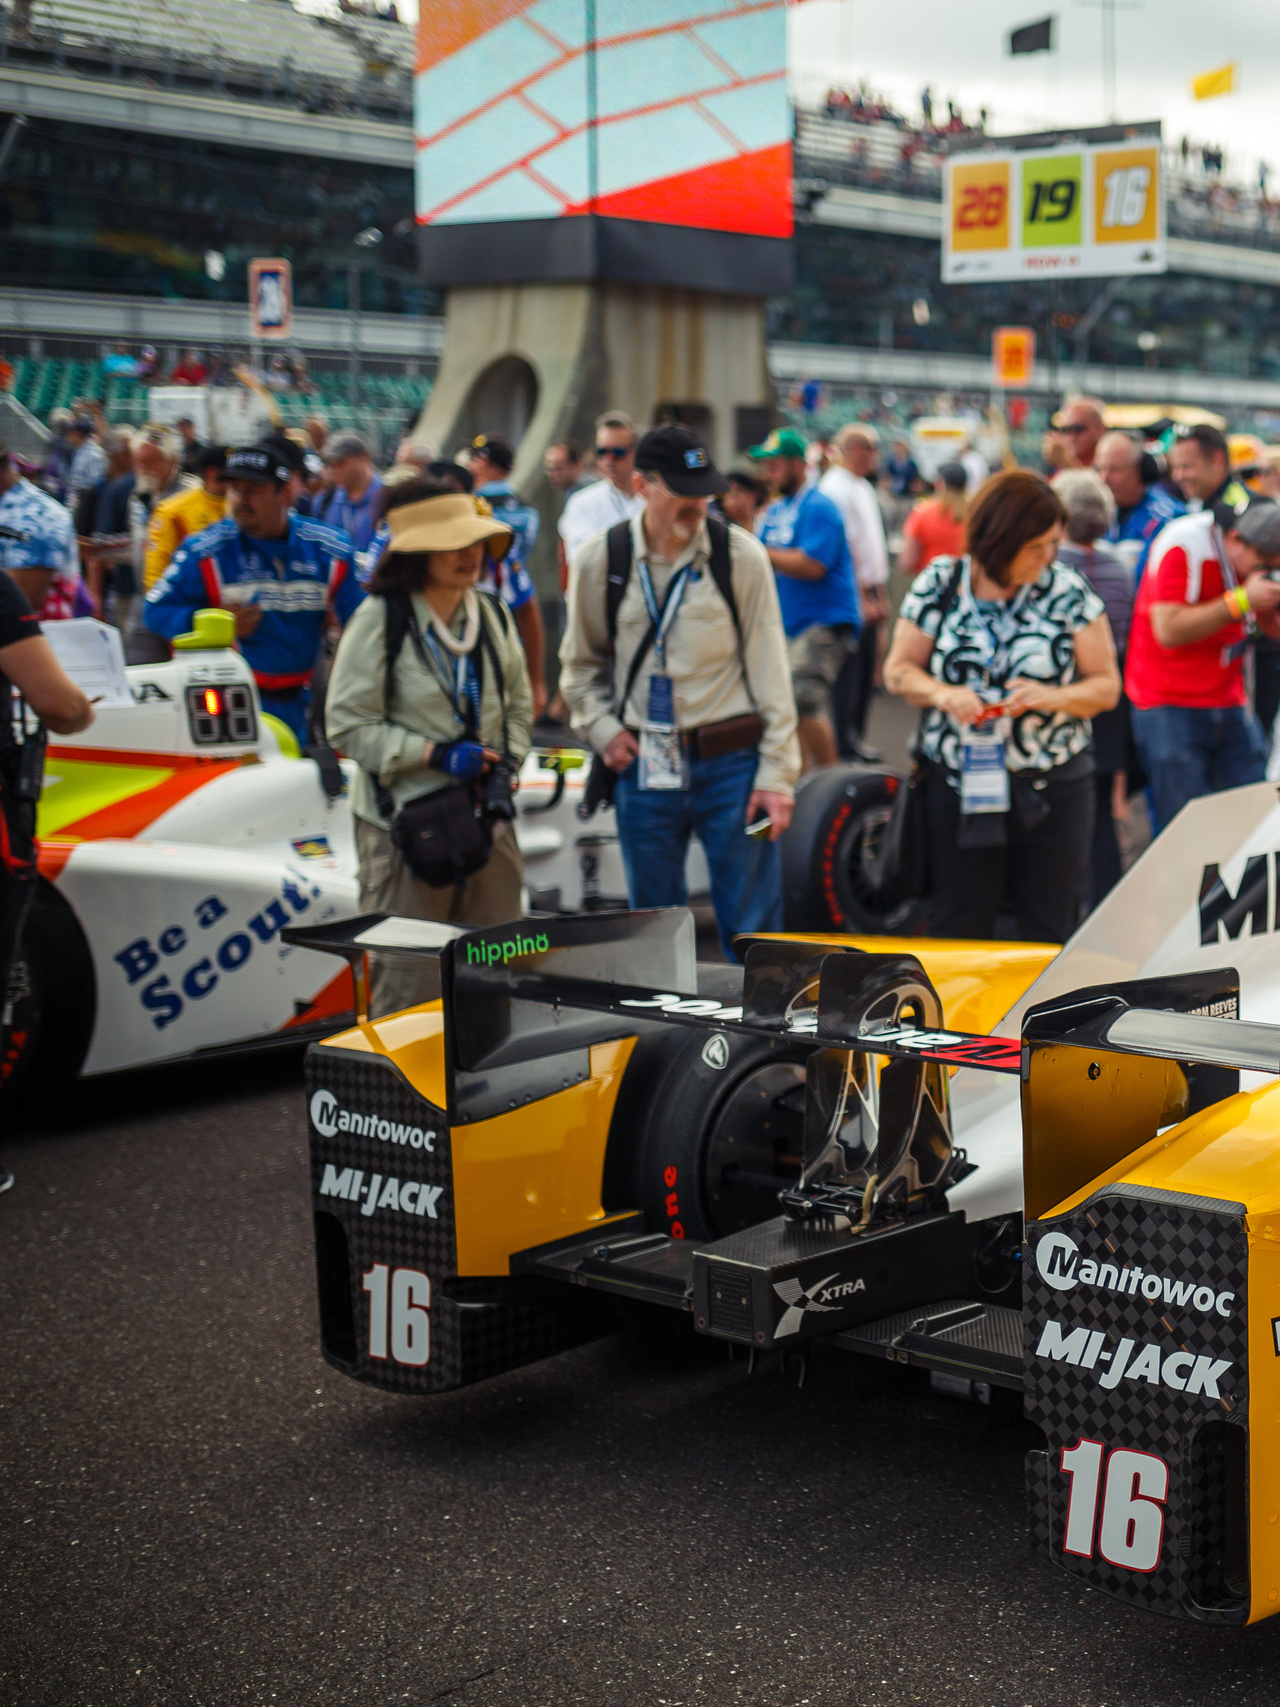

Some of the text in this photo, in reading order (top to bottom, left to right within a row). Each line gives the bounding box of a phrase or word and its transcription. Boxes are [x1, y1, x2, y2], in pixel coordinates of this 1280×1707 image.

[1028, 178, 1078, 225] 19
[1101, 164, 1153, 230] 16
[113, 894, 230, 985] Be a
[1210, 997, 1237, 1016] REEVES
[311, 1091, 436, 1153] Manitowoc
[319, 1163, 445, 1219] MI-JACK
[820, 1278, 866, 1303] XTRA
[1038, 1236, 1235, 1317] Manitowoc
[361, 1261, 431, 1368] 16
[1035, 1319, 1234, 1400] MI-JACK
[1060, 1437, 1169, 1573] 16
